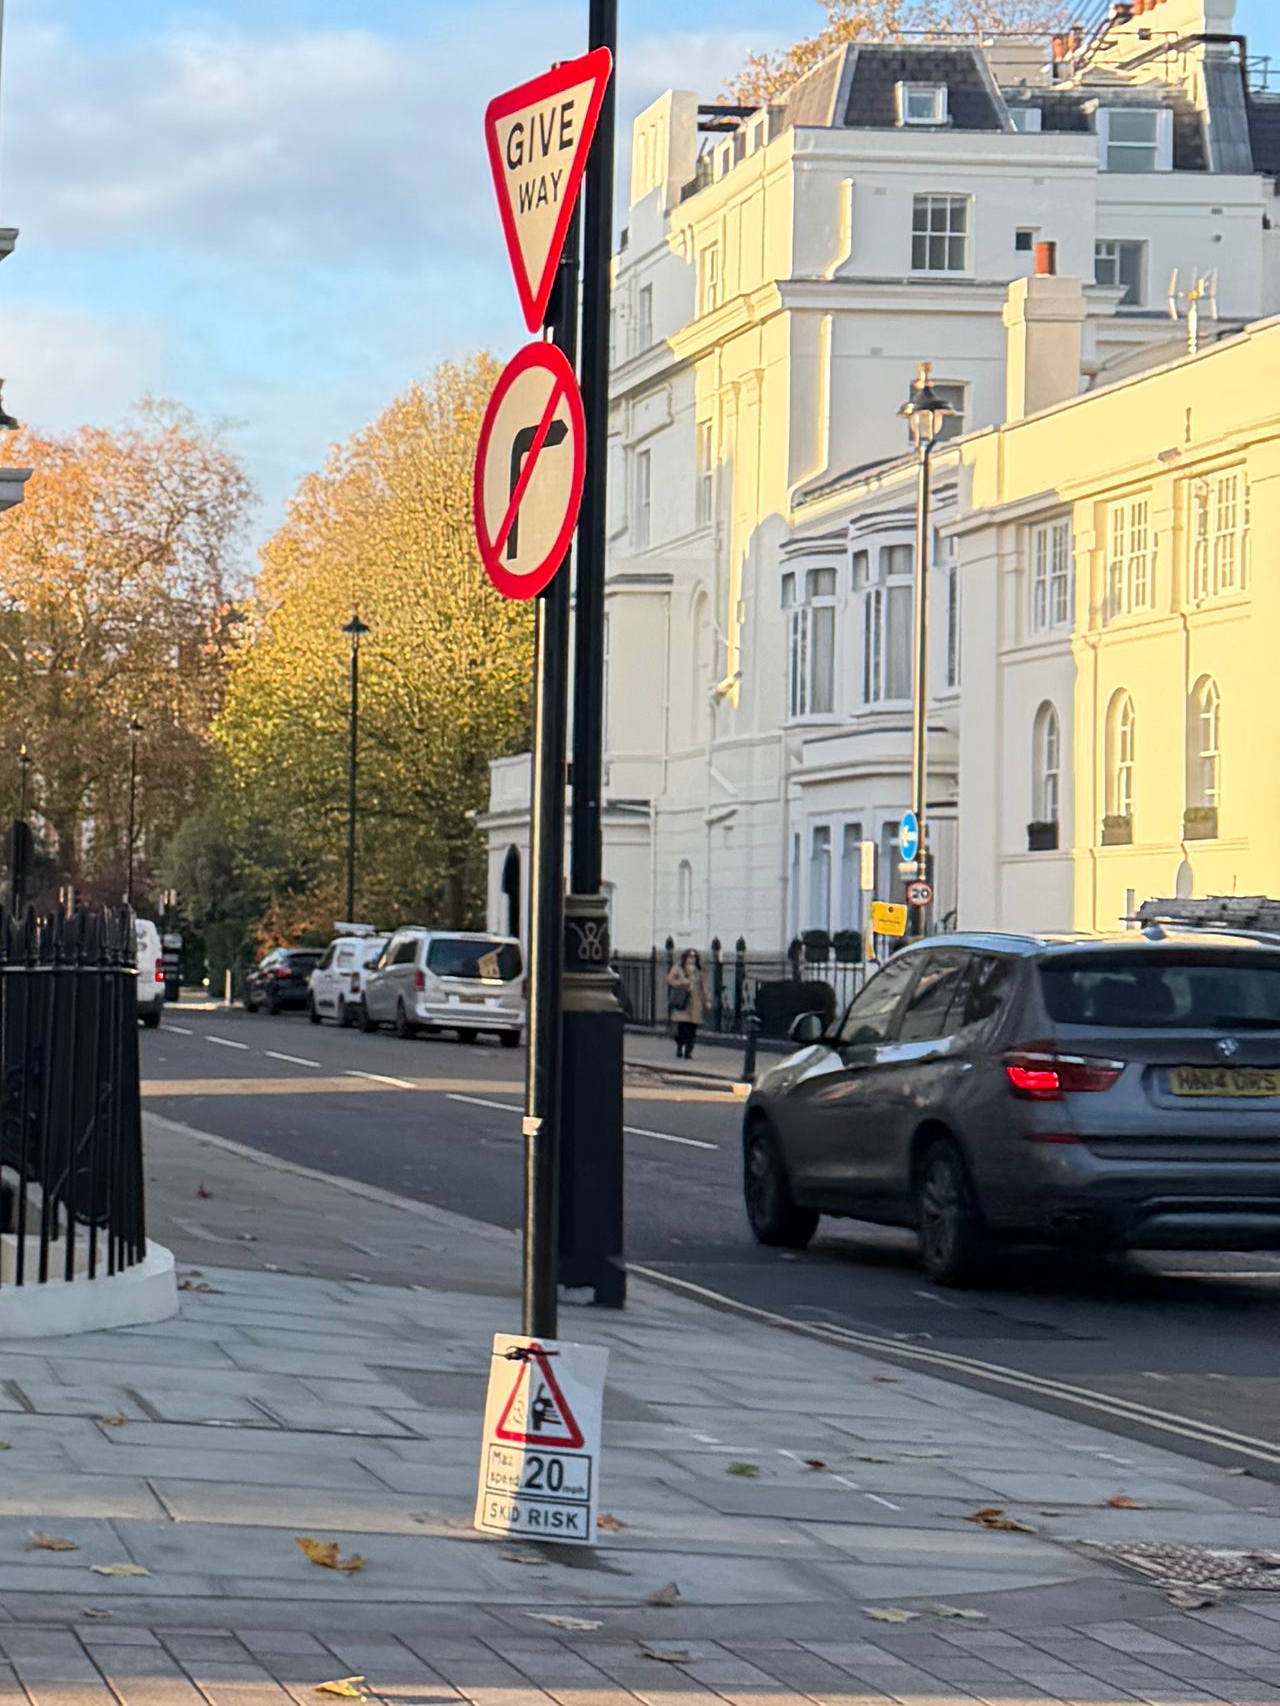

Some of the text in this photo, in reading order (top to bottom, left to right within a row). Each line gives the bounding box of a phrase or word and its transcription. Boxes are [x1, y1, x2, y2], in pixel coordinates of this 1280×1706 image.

[507, 99, 574, 170] GIVE
[518, 169, 563, 214] WAY
[524, 1456, 585, 1495] 20 mph
[490, 1502, 579, 1530] SKID RISK
